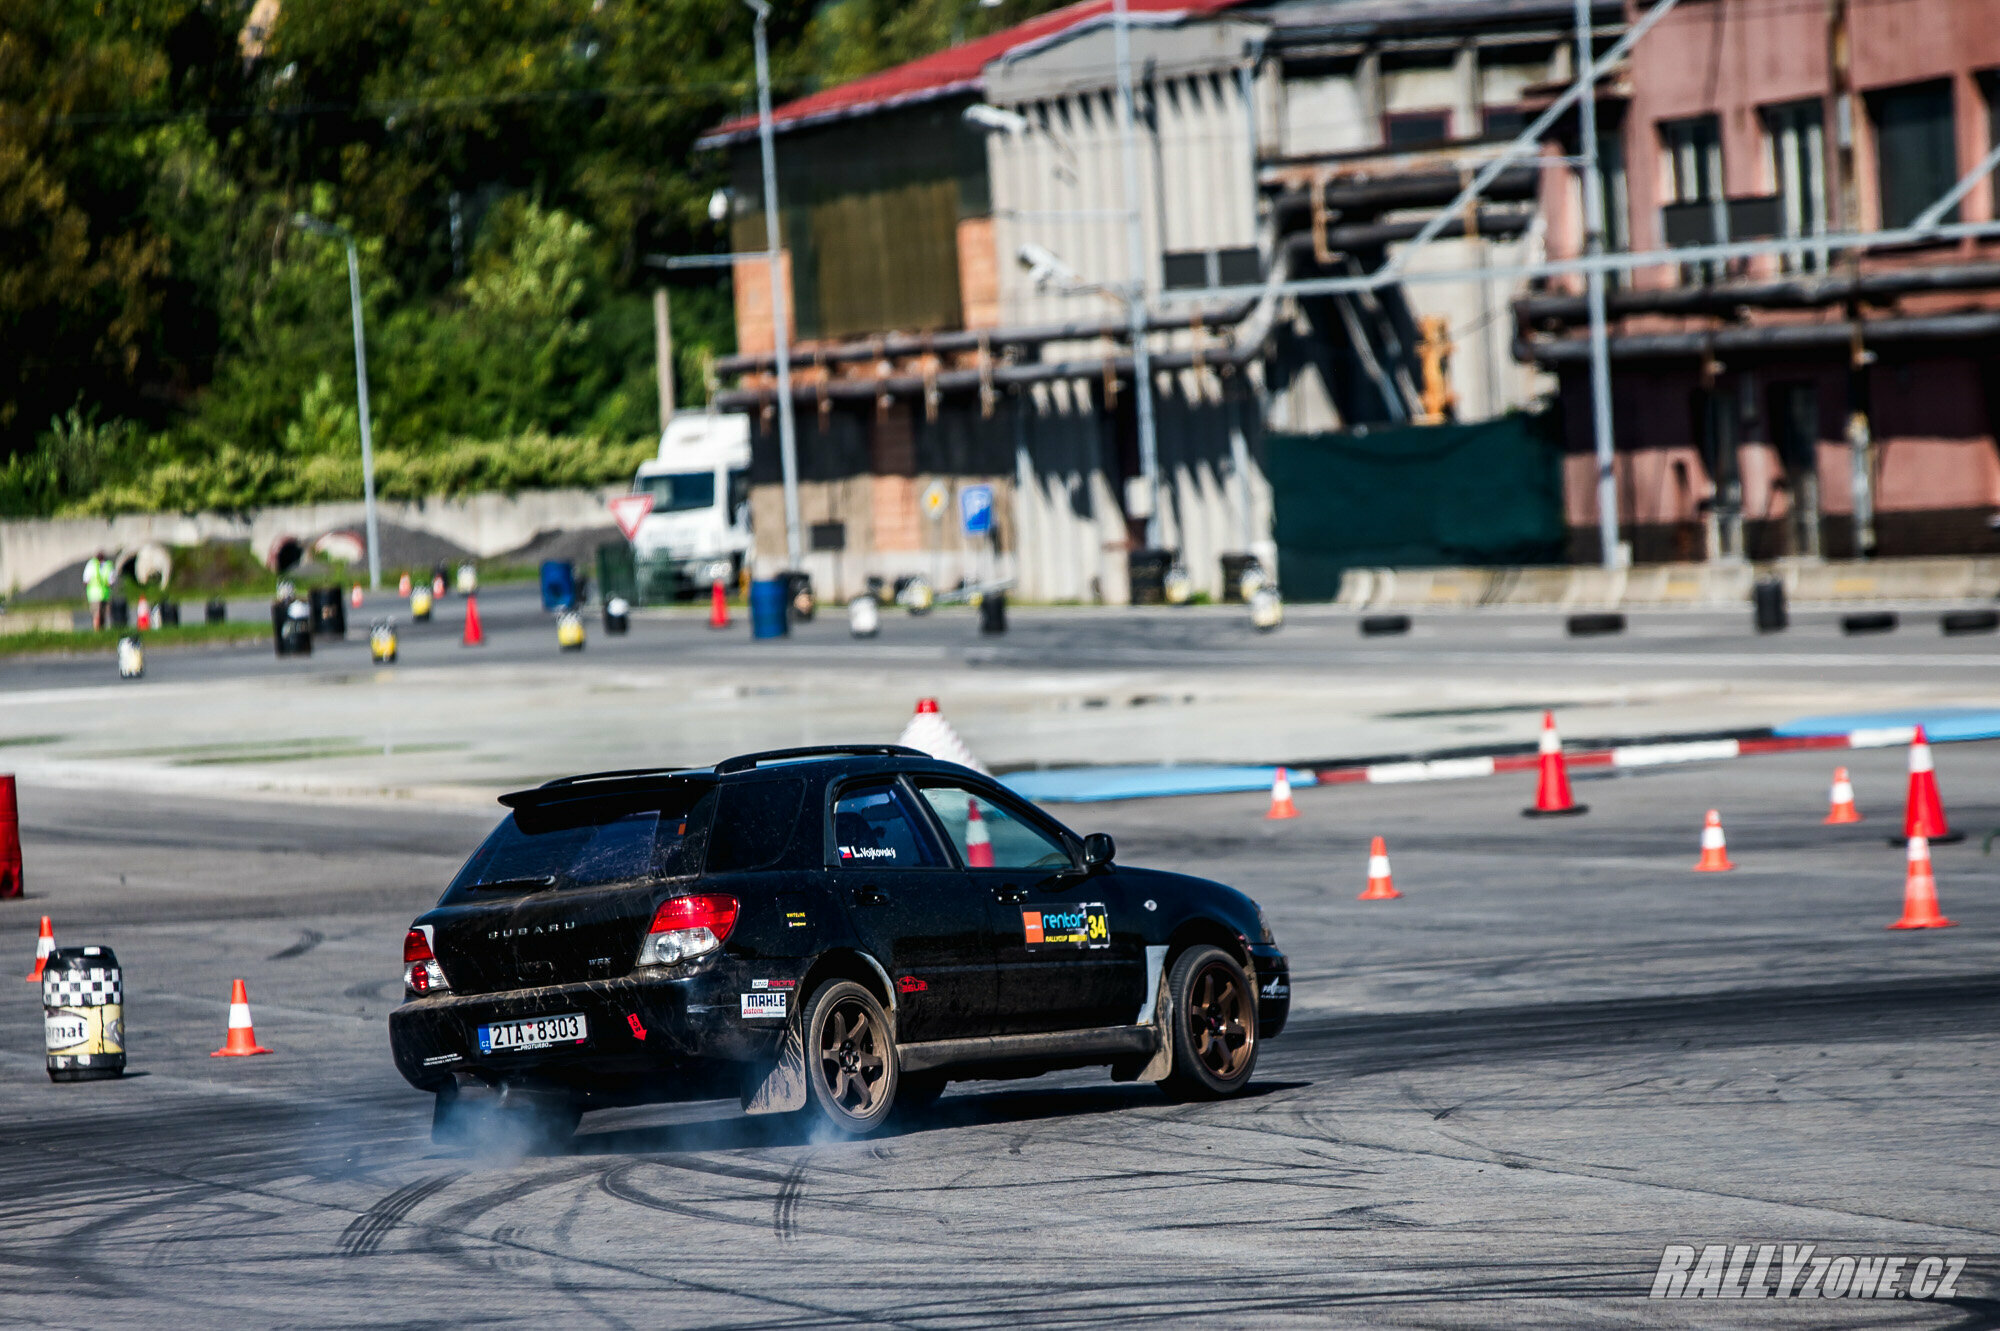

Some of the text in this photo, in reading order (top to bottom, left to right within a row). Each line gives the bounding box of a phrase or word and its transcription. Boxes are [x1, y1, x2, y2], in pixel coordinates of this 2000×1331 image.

[1043, 912, 1084, 928] rentor
[1088, 915, 1106, 938] 34
[488, 921, 575, 939] SUBARU
[747, 994, 786, 1007] MAHLE
[493, 1016, 579, 1047] 2TA 8303
[481, 1040, 490, 1048] CZ
